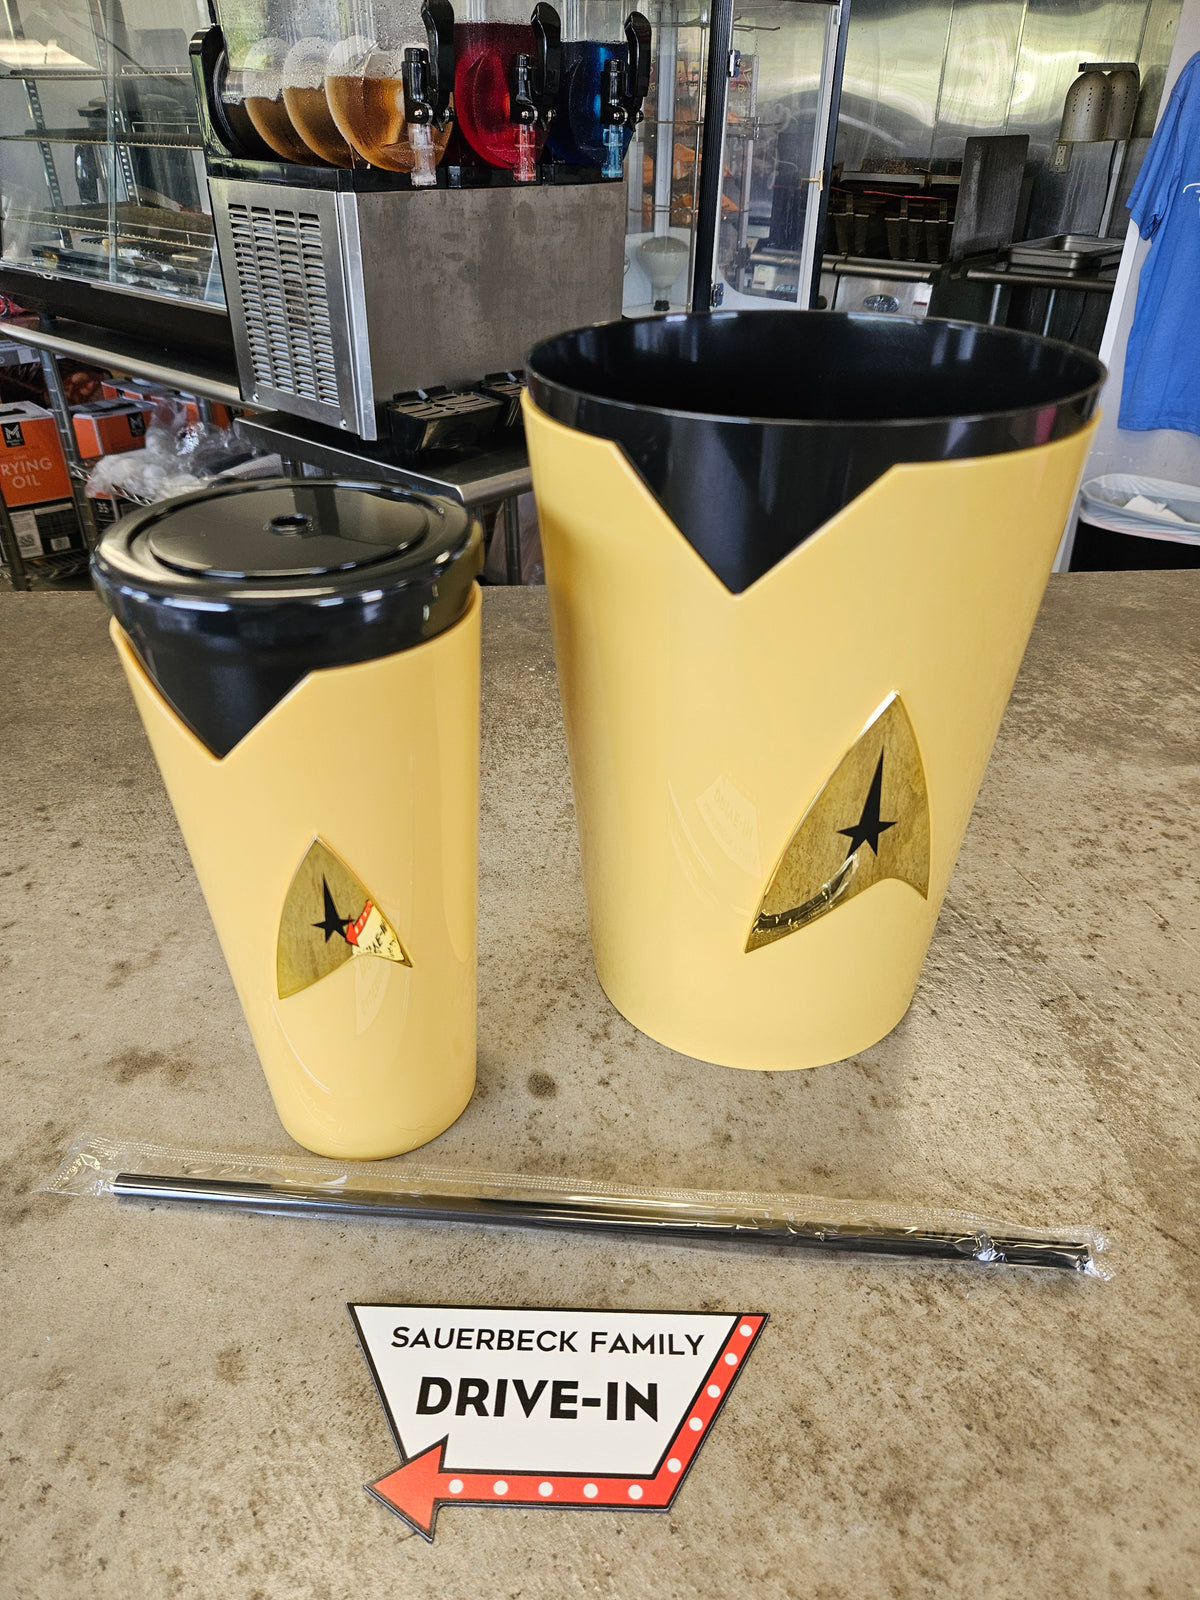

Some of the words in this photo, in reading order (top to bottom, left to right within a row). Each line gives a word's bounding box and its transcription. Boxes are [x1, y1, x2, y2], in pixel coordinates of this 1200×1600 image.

[0, 457, 53, 477] RYING
[12, 474, 41, 489] OIL
[391, 1326, 579, 1353] SAUERBECK
[590, 1331, 705, 1357] FAMILY
[415, 1376, 659, 1423] DRIVE-IN
